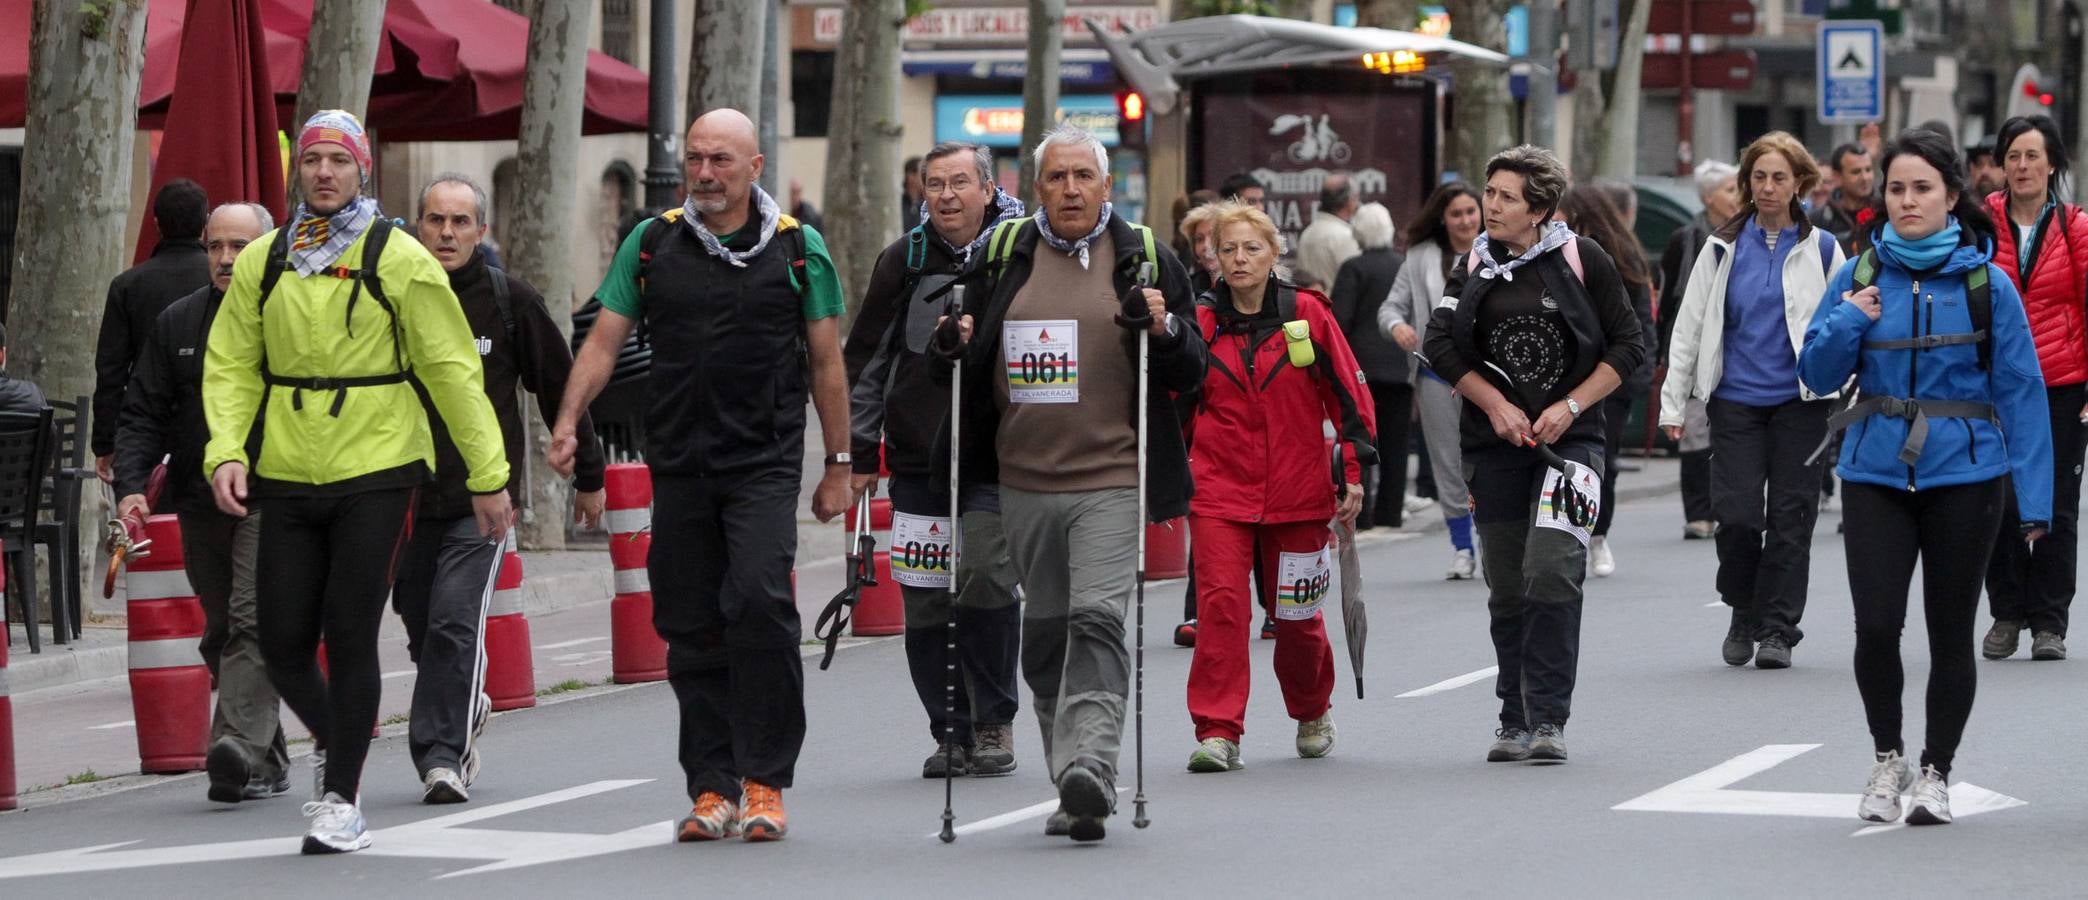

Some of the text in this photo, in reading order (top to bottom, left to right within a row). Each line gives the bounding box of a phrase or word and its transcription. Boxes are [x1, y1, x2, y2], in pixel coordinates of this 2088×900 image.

[1062, 11, 1154, 34] MERCIALES
[1022, 352, 1069, 384] 061
[903, 573, 950, 583] VALVANERAD
